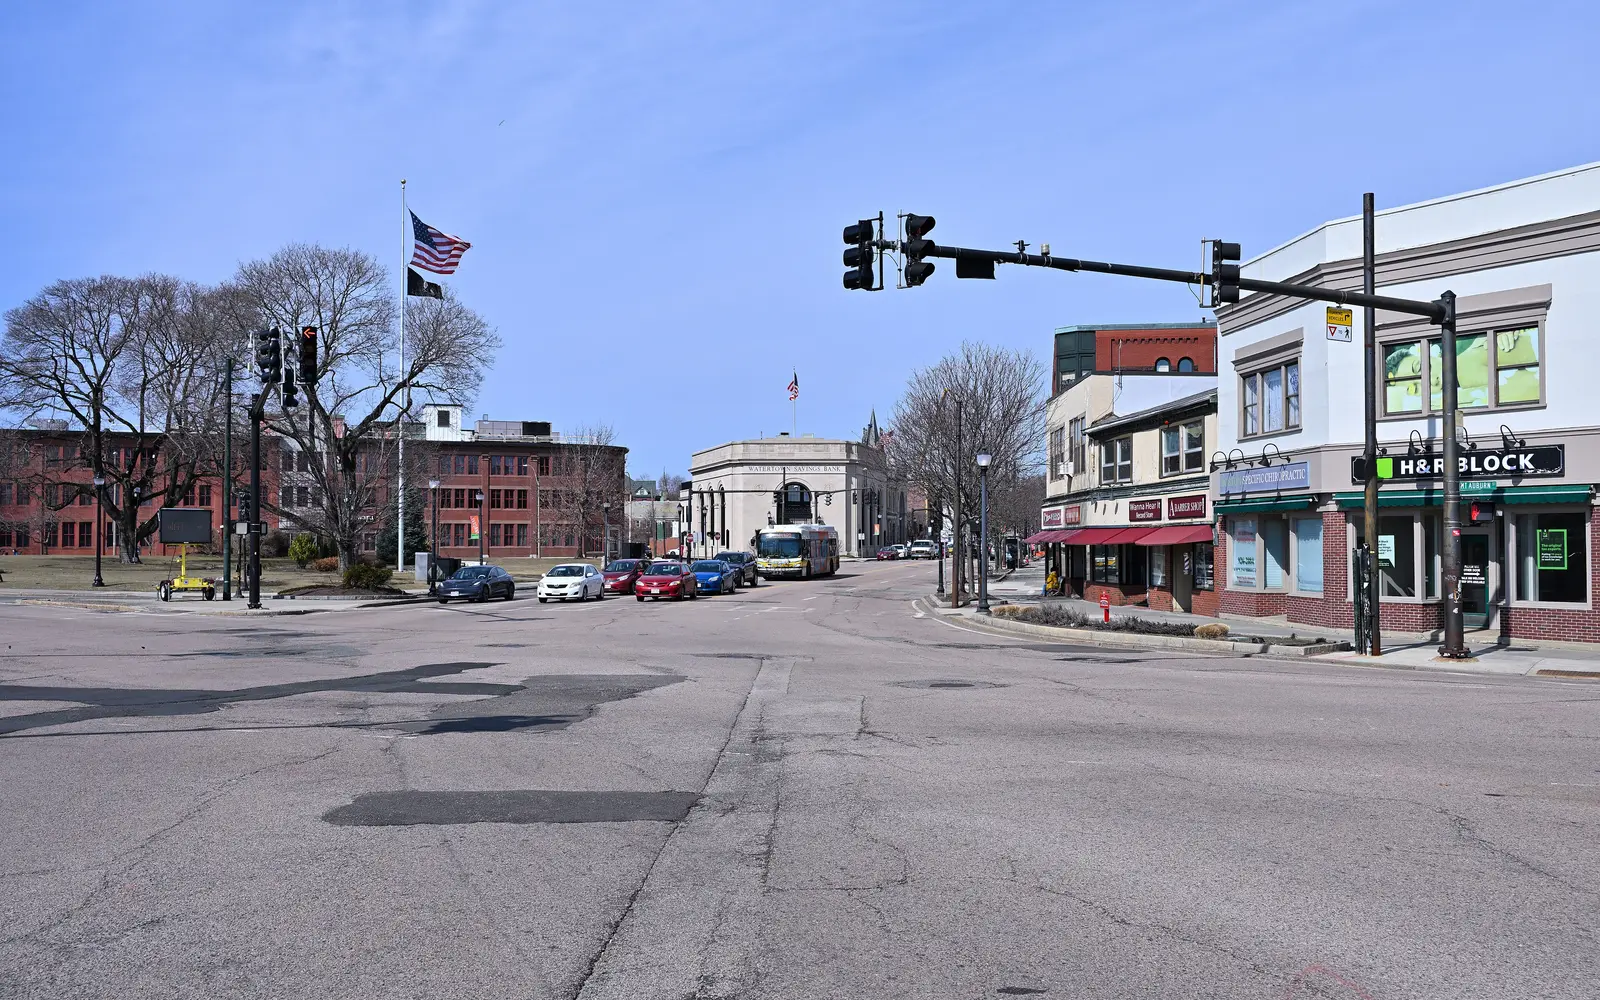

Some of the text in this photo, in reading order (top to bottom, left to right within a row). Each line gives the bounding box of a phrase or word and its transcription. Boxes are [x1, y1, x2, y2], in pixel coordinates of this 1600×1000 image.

[1400, 458, 1444, 475] H&R
[1242, 473, 1265, 485] SPECIFIC
[1264, 468, 1306, 482] CHIROPRACTIC
[1129, 503, 1145, 511] Wanna
[1145, 502, 1157, 510] Hear
[1169, 500, 1202, 517] A BARBER SHOP
